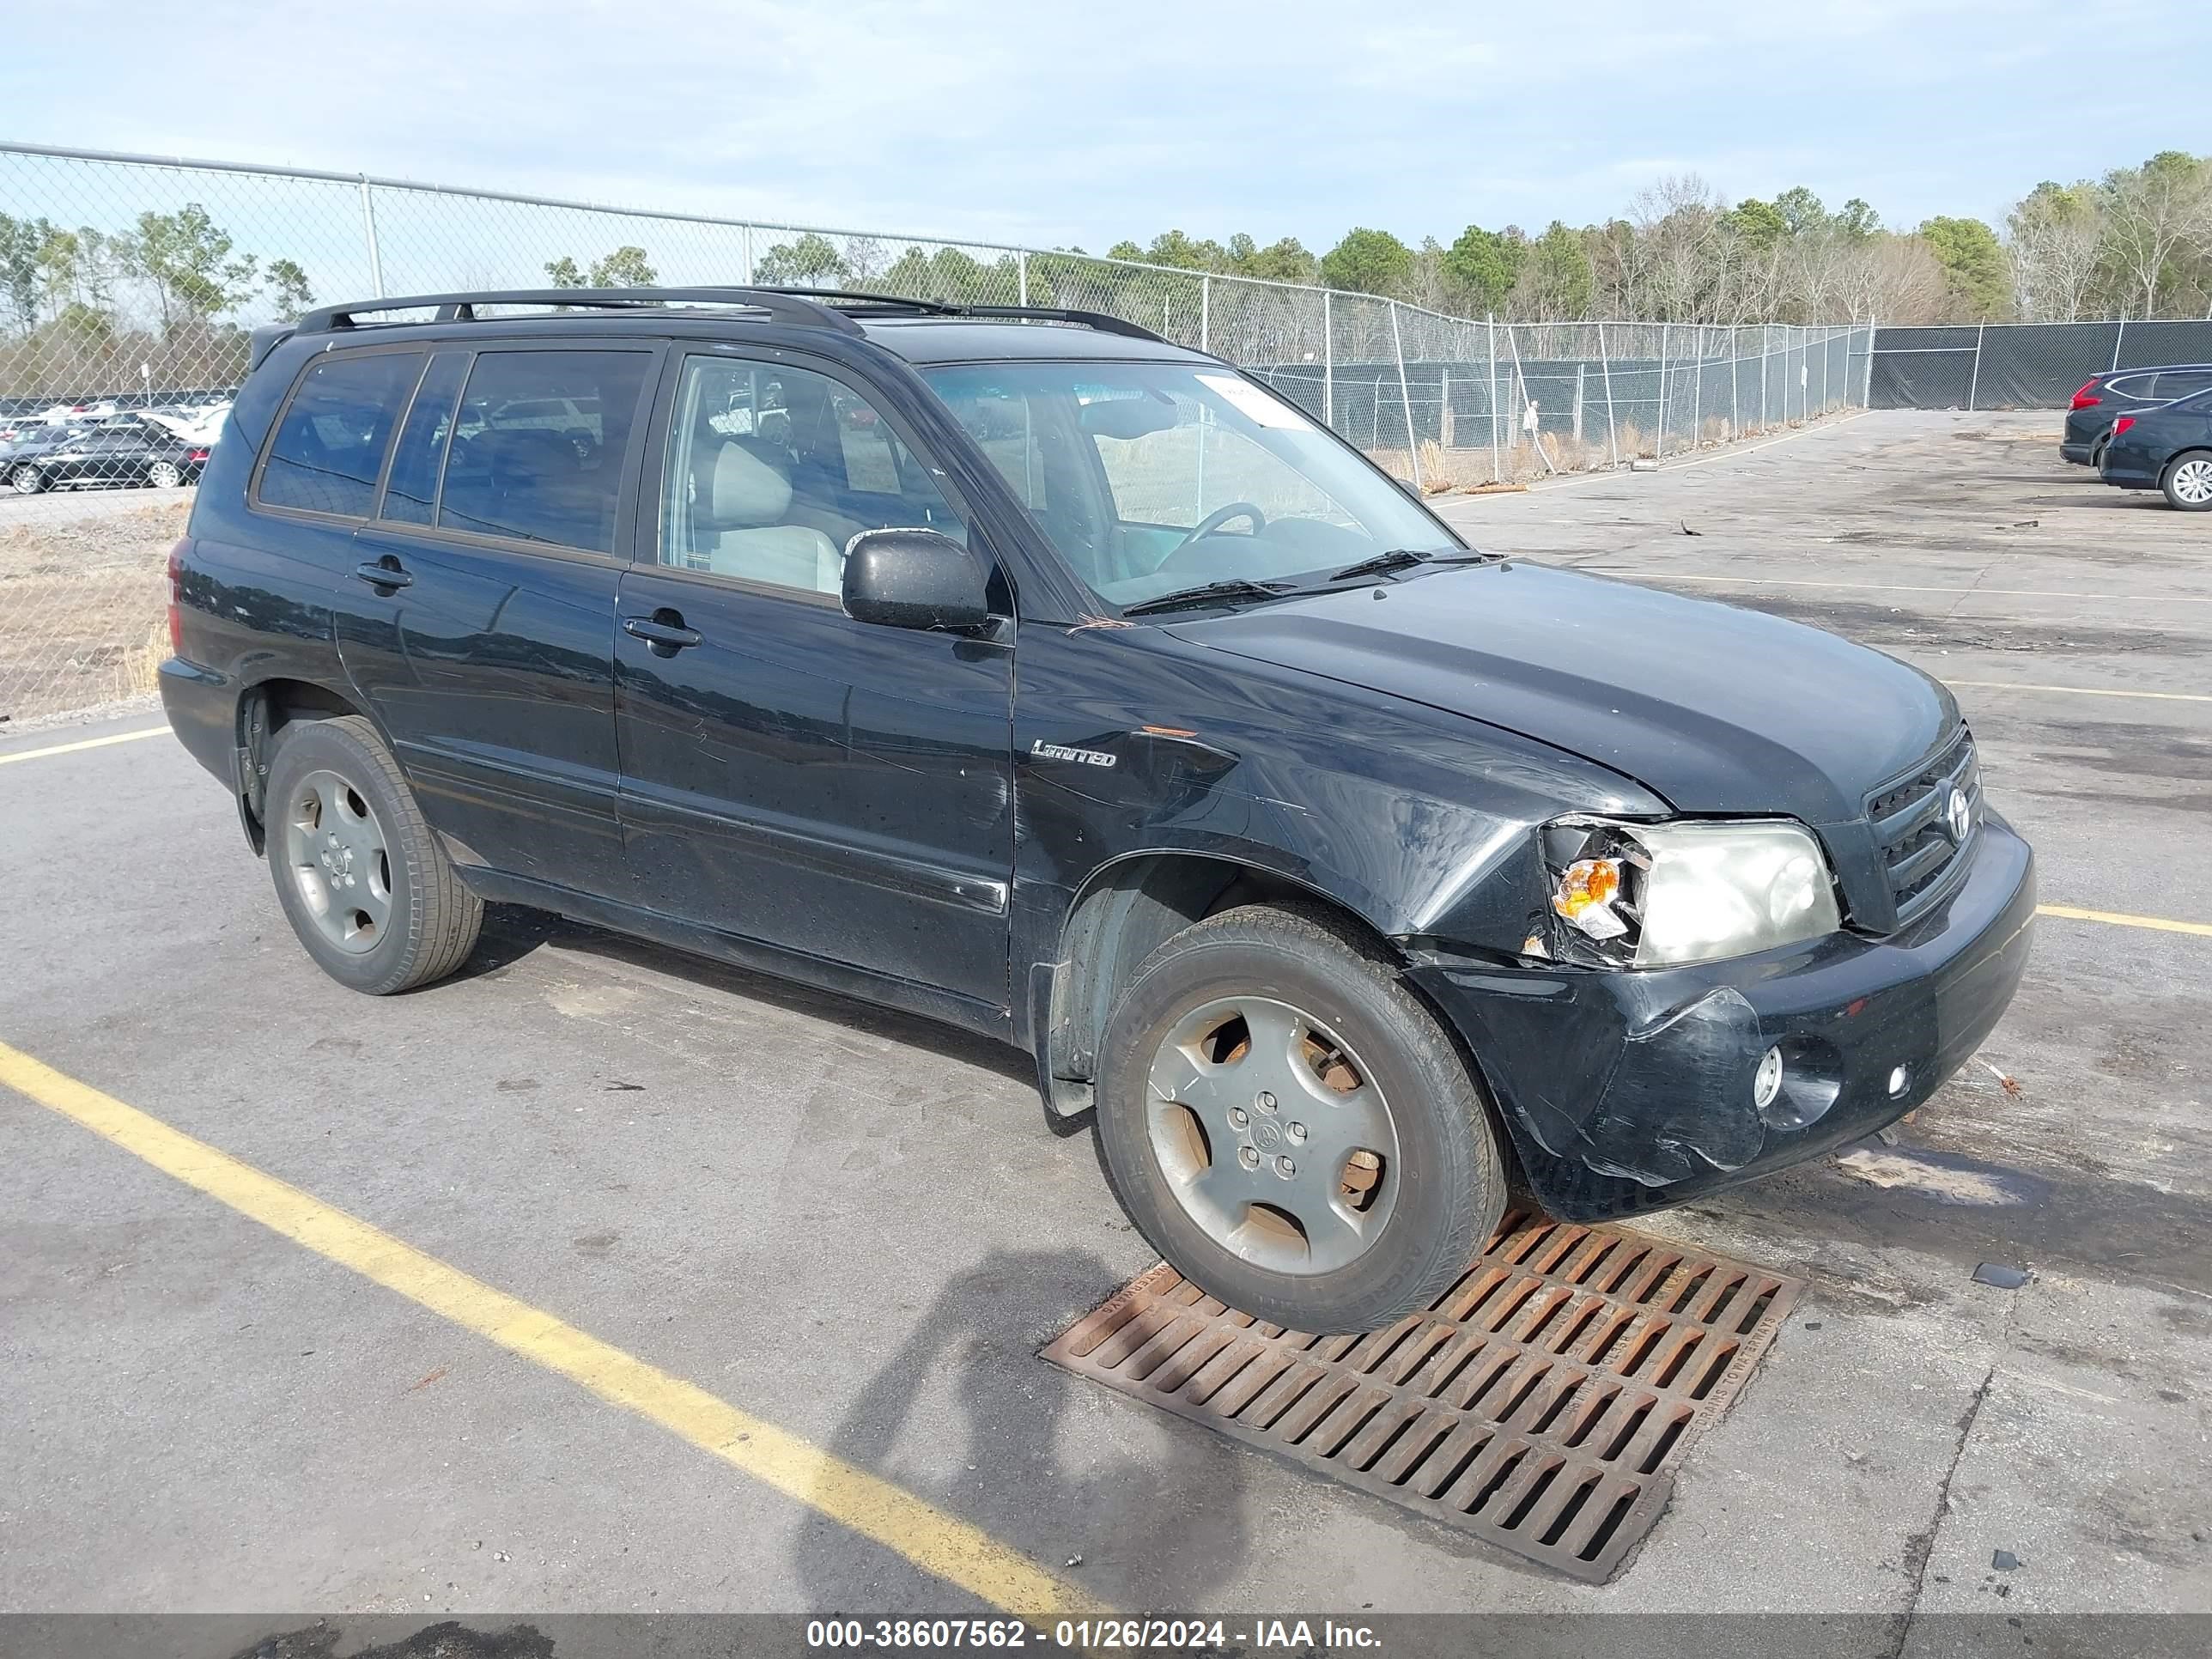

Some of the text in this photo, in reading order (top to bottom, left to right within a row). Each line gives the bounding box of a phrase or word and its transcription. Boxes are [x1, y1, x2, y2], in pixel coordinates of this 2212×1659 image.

[1030, 739, 1117, 768] LIMITED
[1695, 1389, 1729, 1426] DRAINS
[1723, 1372, 1739, 1385] TO
[1732, 1317, 1776, 1372] WATERWAYS
